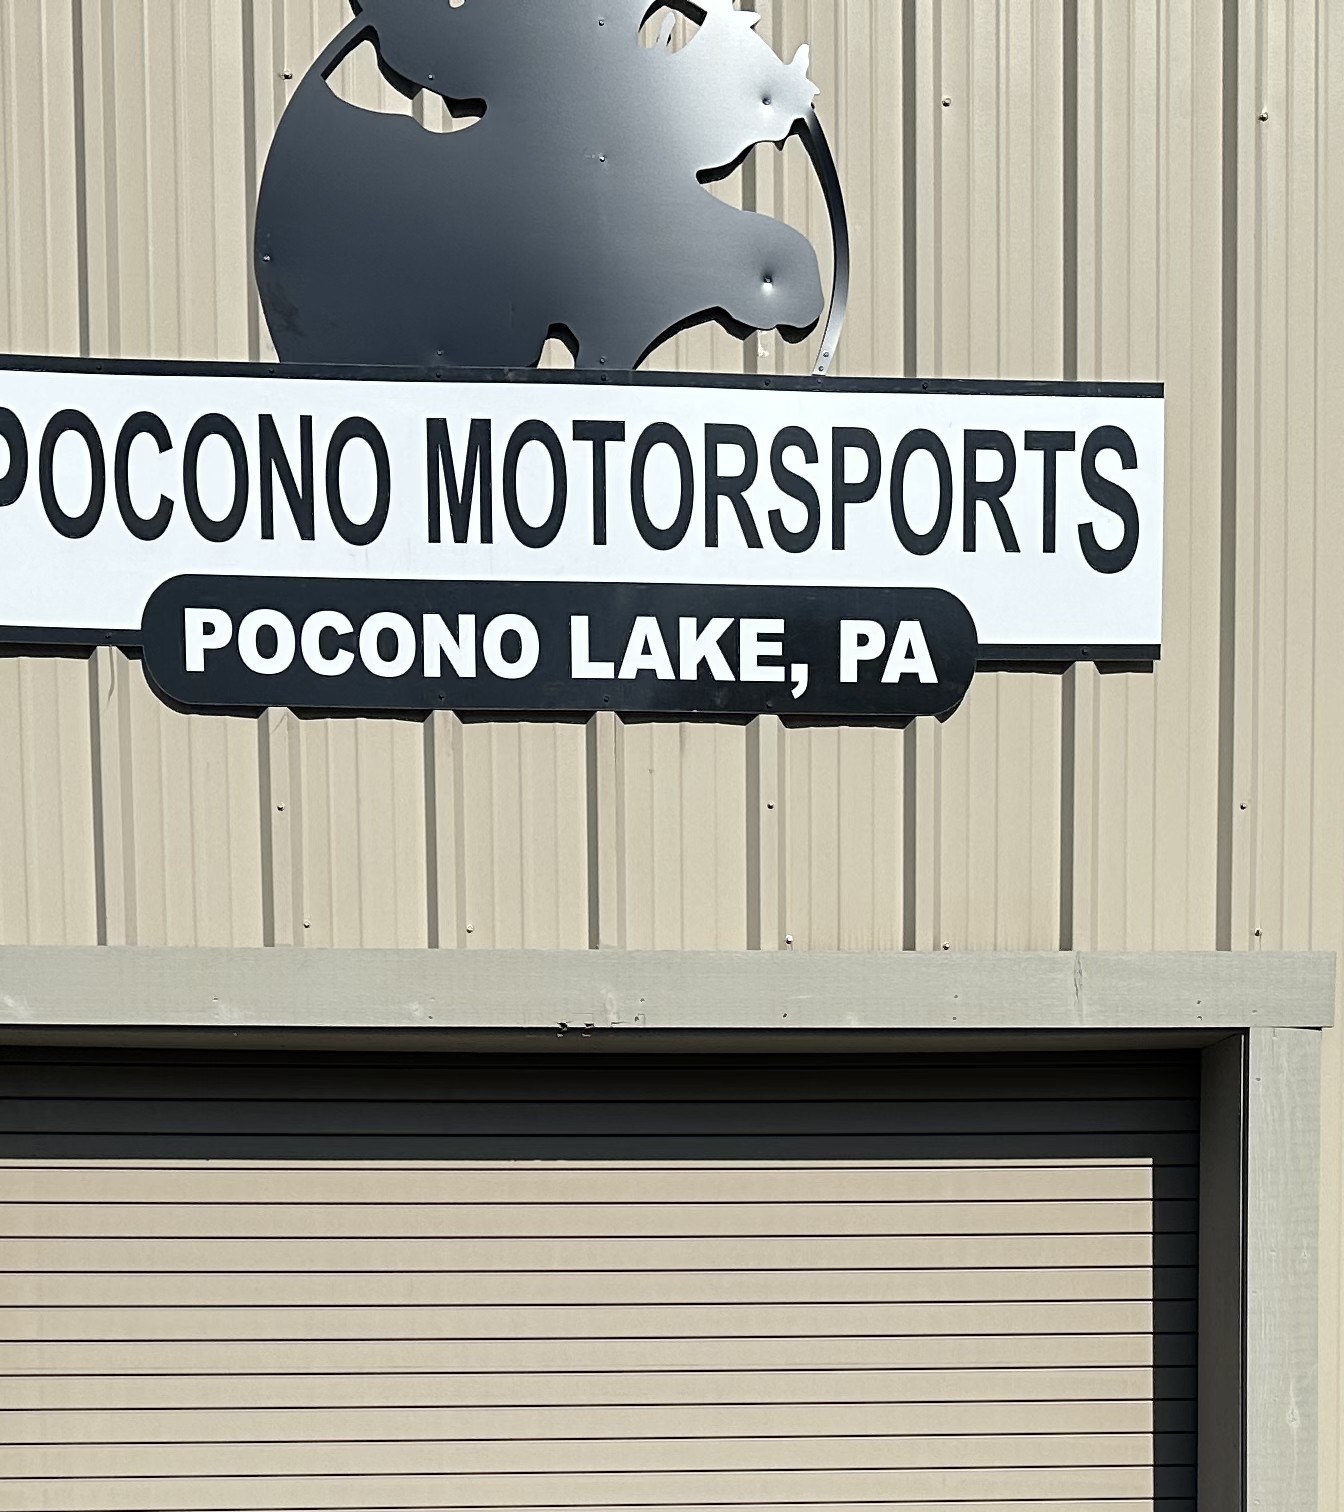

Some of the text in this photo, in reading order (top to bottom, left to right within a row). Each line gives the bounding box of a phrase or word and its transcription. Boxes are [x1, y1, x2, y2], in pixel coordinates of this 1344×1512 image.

[426, 417, 1140, 574] MOTORSPORTS
[183, 607, 938, 699] POCONO LAKE, PA
